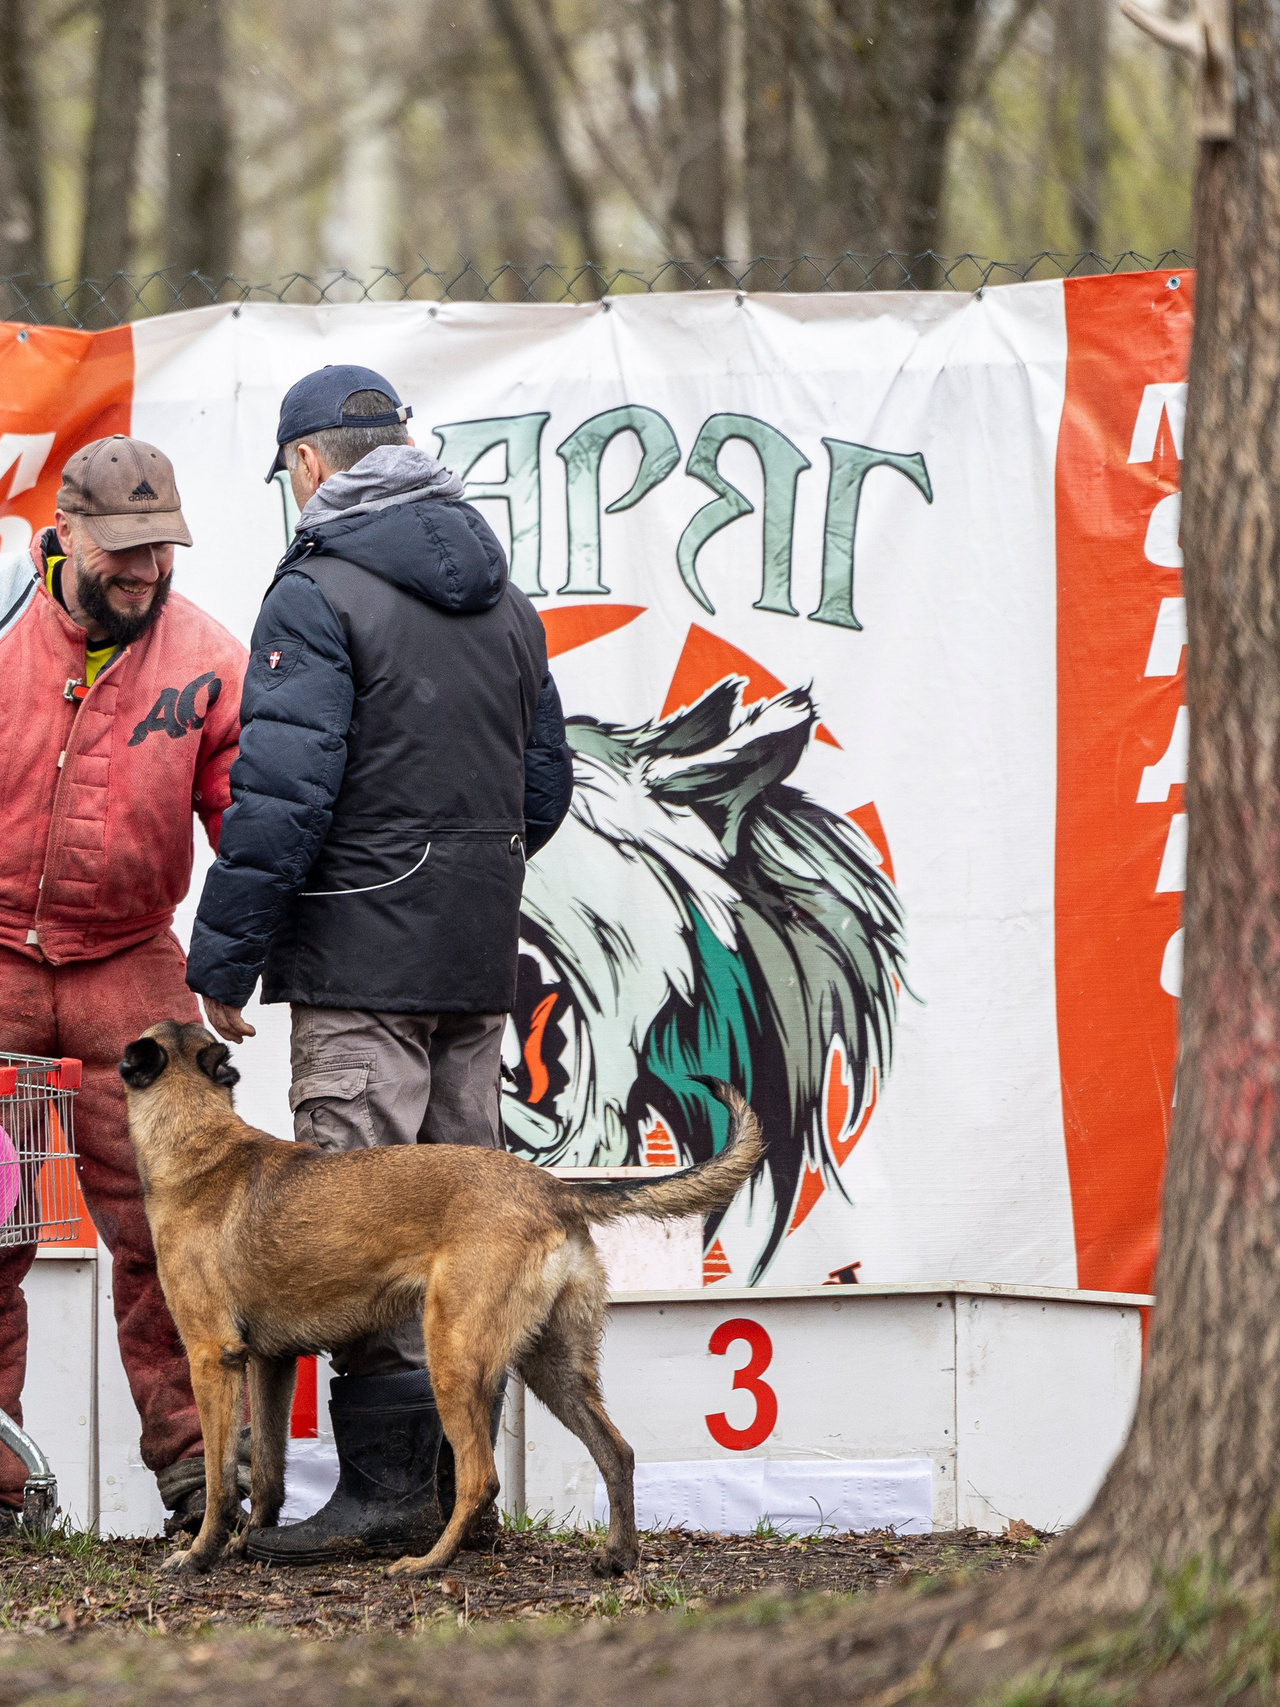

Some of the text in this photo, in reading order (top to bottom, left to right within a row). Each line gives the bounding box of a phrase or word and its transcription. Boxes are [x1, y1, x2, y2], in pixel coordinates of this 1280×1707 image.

[128, 492, 159, 502] adidas
[274, 404, 934, 631] АРЯГ
[704, 1317, 779, 1451] 3
